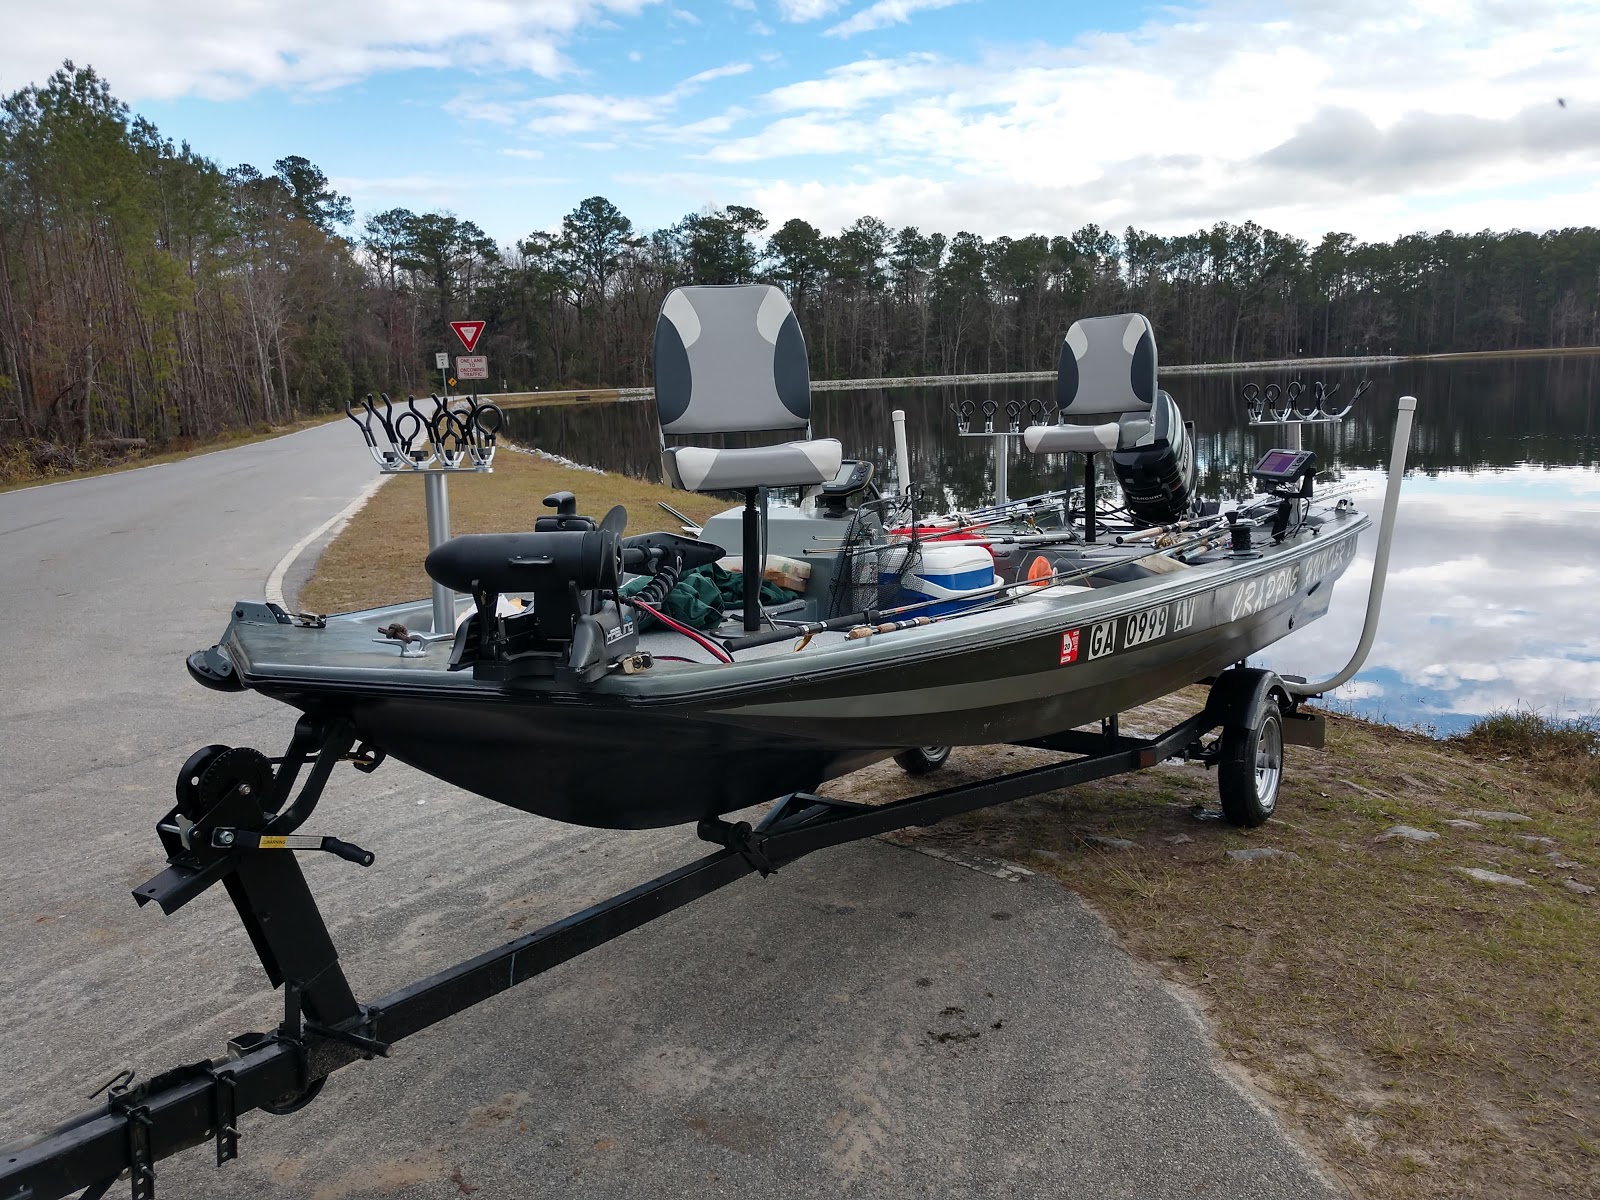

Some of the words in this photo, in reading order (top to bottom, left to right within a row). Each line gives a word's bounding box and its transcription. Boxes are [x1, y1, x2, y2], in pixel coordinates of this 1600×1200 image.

[1231, 565, 1300, 622] CRAPPIE
[1091, 621, 1114, 657] GA
[1126, 606, 1167, 646] 0999
[1175, 598, 1195, 631] AV
